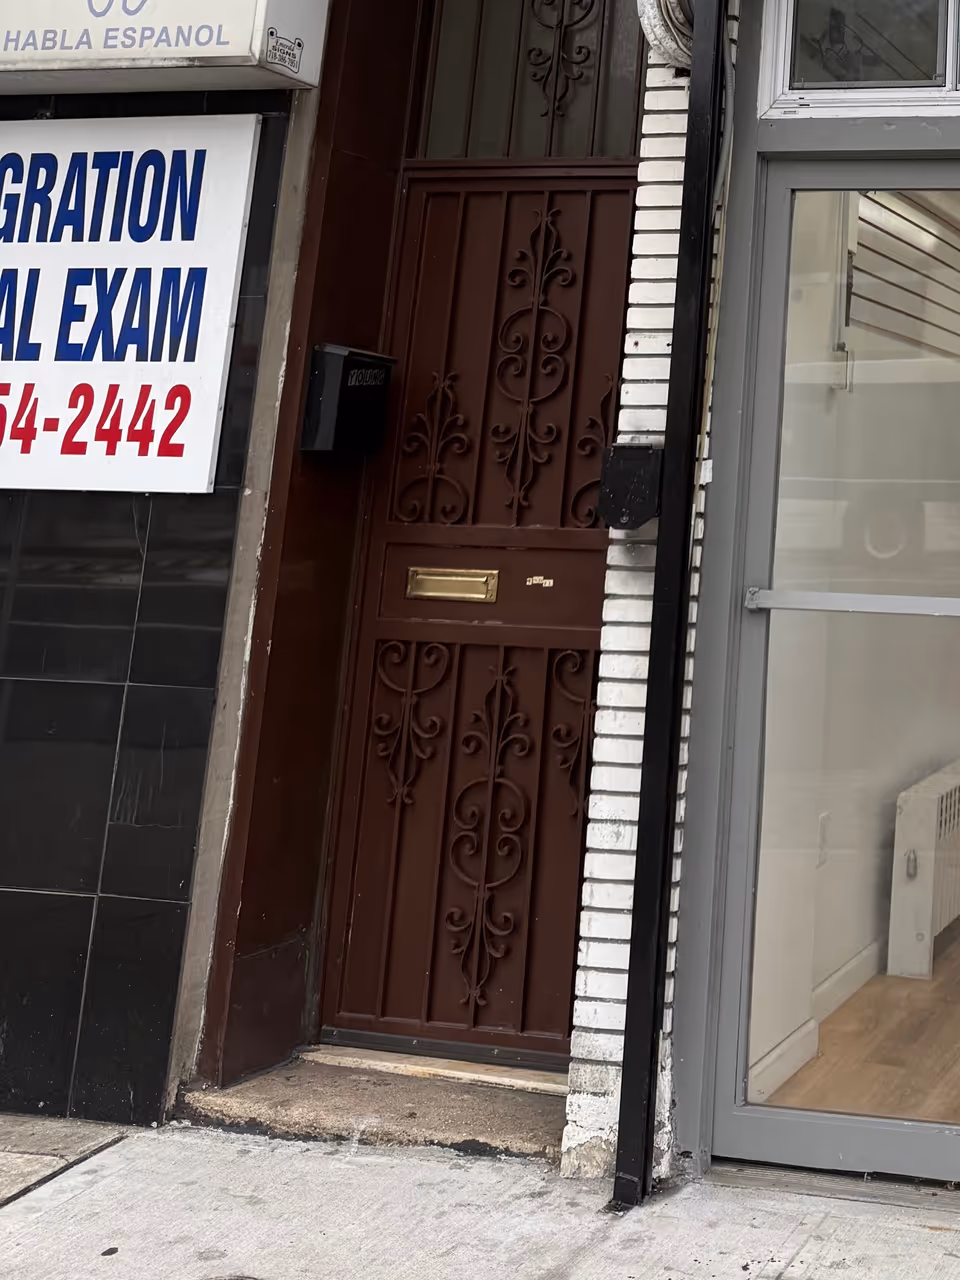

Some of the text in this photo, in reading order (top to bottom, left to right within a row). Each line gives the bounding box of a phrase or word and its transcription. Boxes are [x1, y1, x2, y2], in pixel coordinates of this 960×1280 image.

[3, 24, 231, 52] HABLA ESPANOL
[272, 45, 297, 59] SIGNS
[0, 148, 207, 243] GRATION
[54, 267, 208, 362] EXAM
